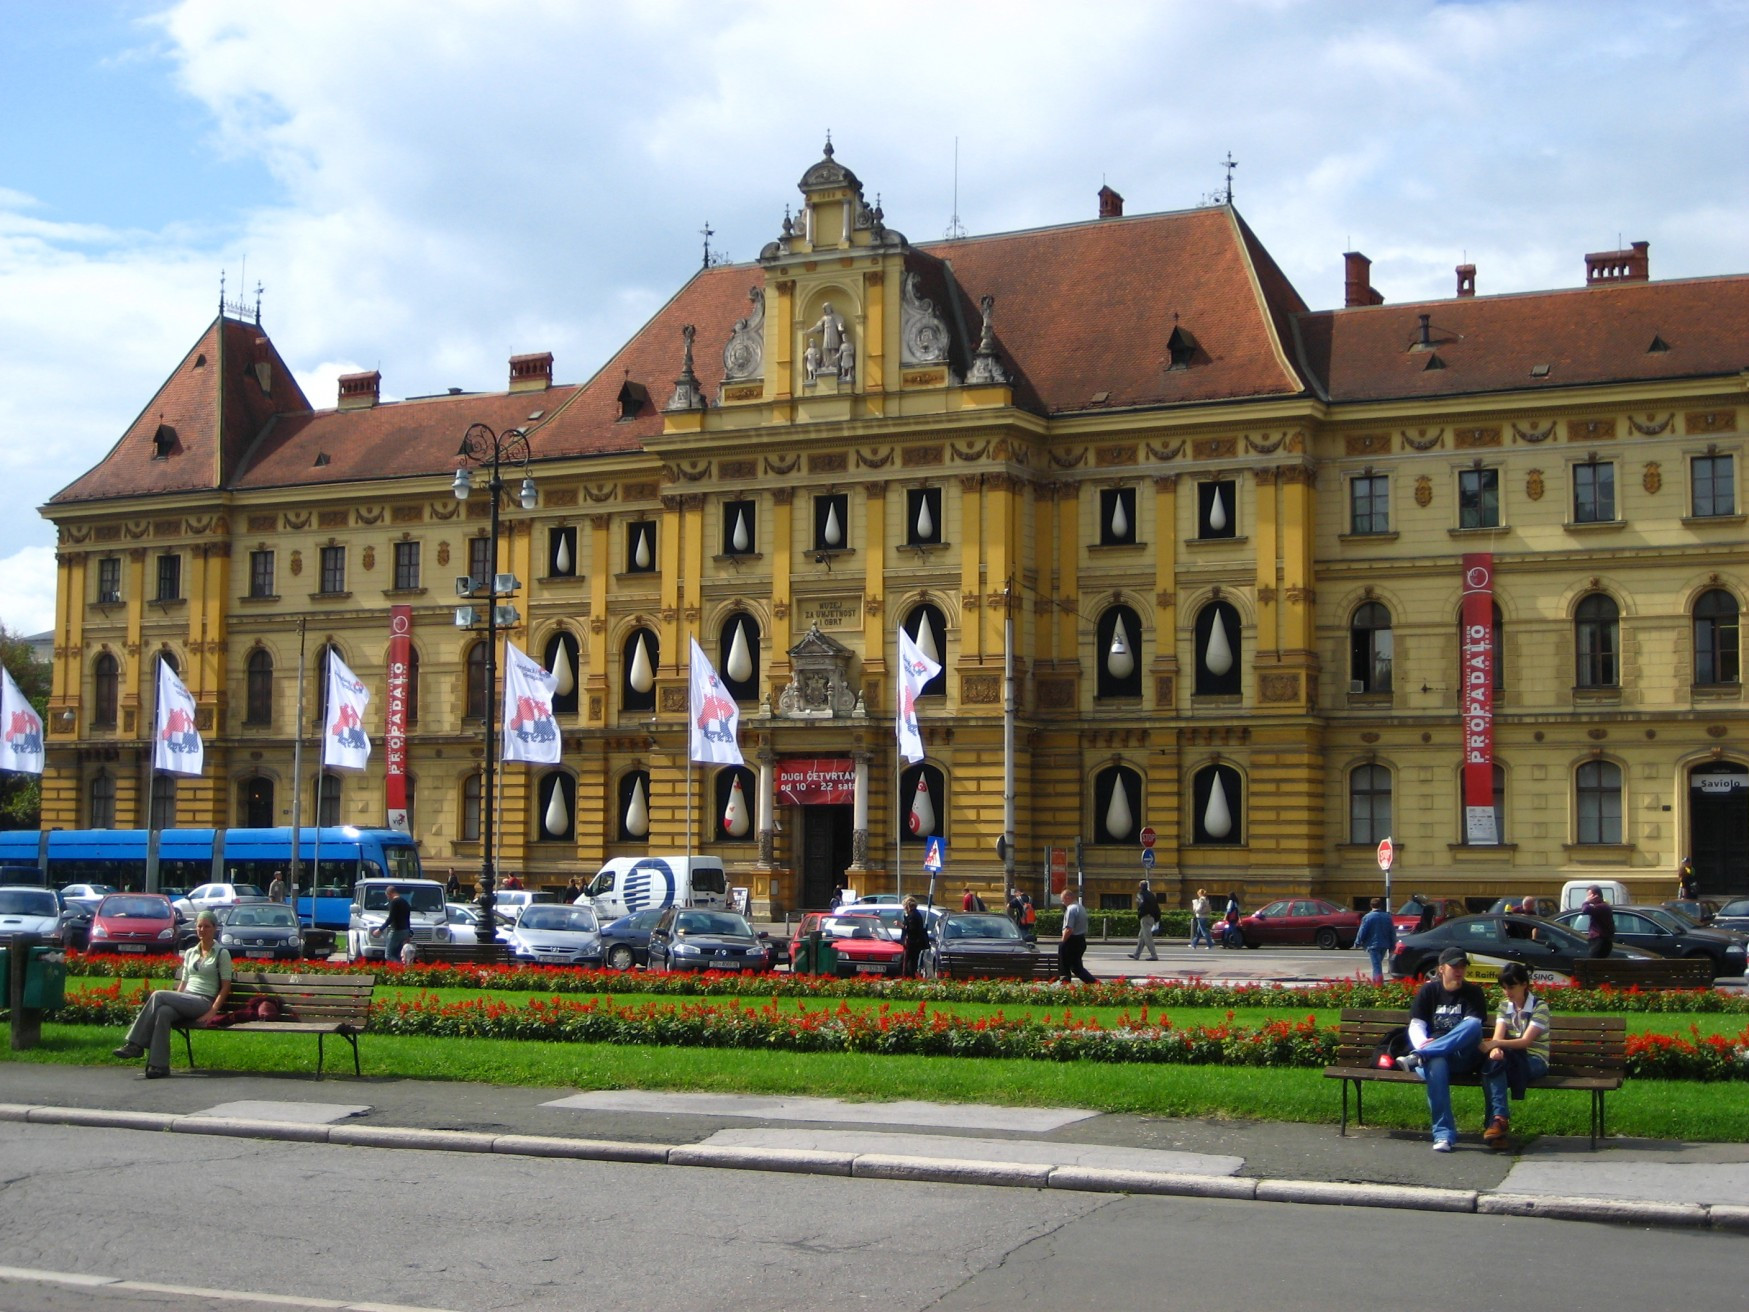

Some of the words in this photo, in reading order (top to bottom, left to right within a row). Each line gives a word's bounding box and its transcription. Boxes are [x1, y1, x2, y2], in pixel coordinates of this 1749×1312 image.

[819, 601, 842, 610] MUZEJ
[805, 611, 814, 619] ZA
[816, 609, 856, 618] UMJETNOST
[824, 618, 842, 626] OBRT
[1471, 624, 1485, 763] PROPADALO
[391, 662, 403, 774] PROPADALO
[781, 772, 803, 781] DUGI
[807, 771, 856, 780] ČETVRTAK
[781, 783, 792, 791] od
[1701, 779, 1740, 788] Saviolo
